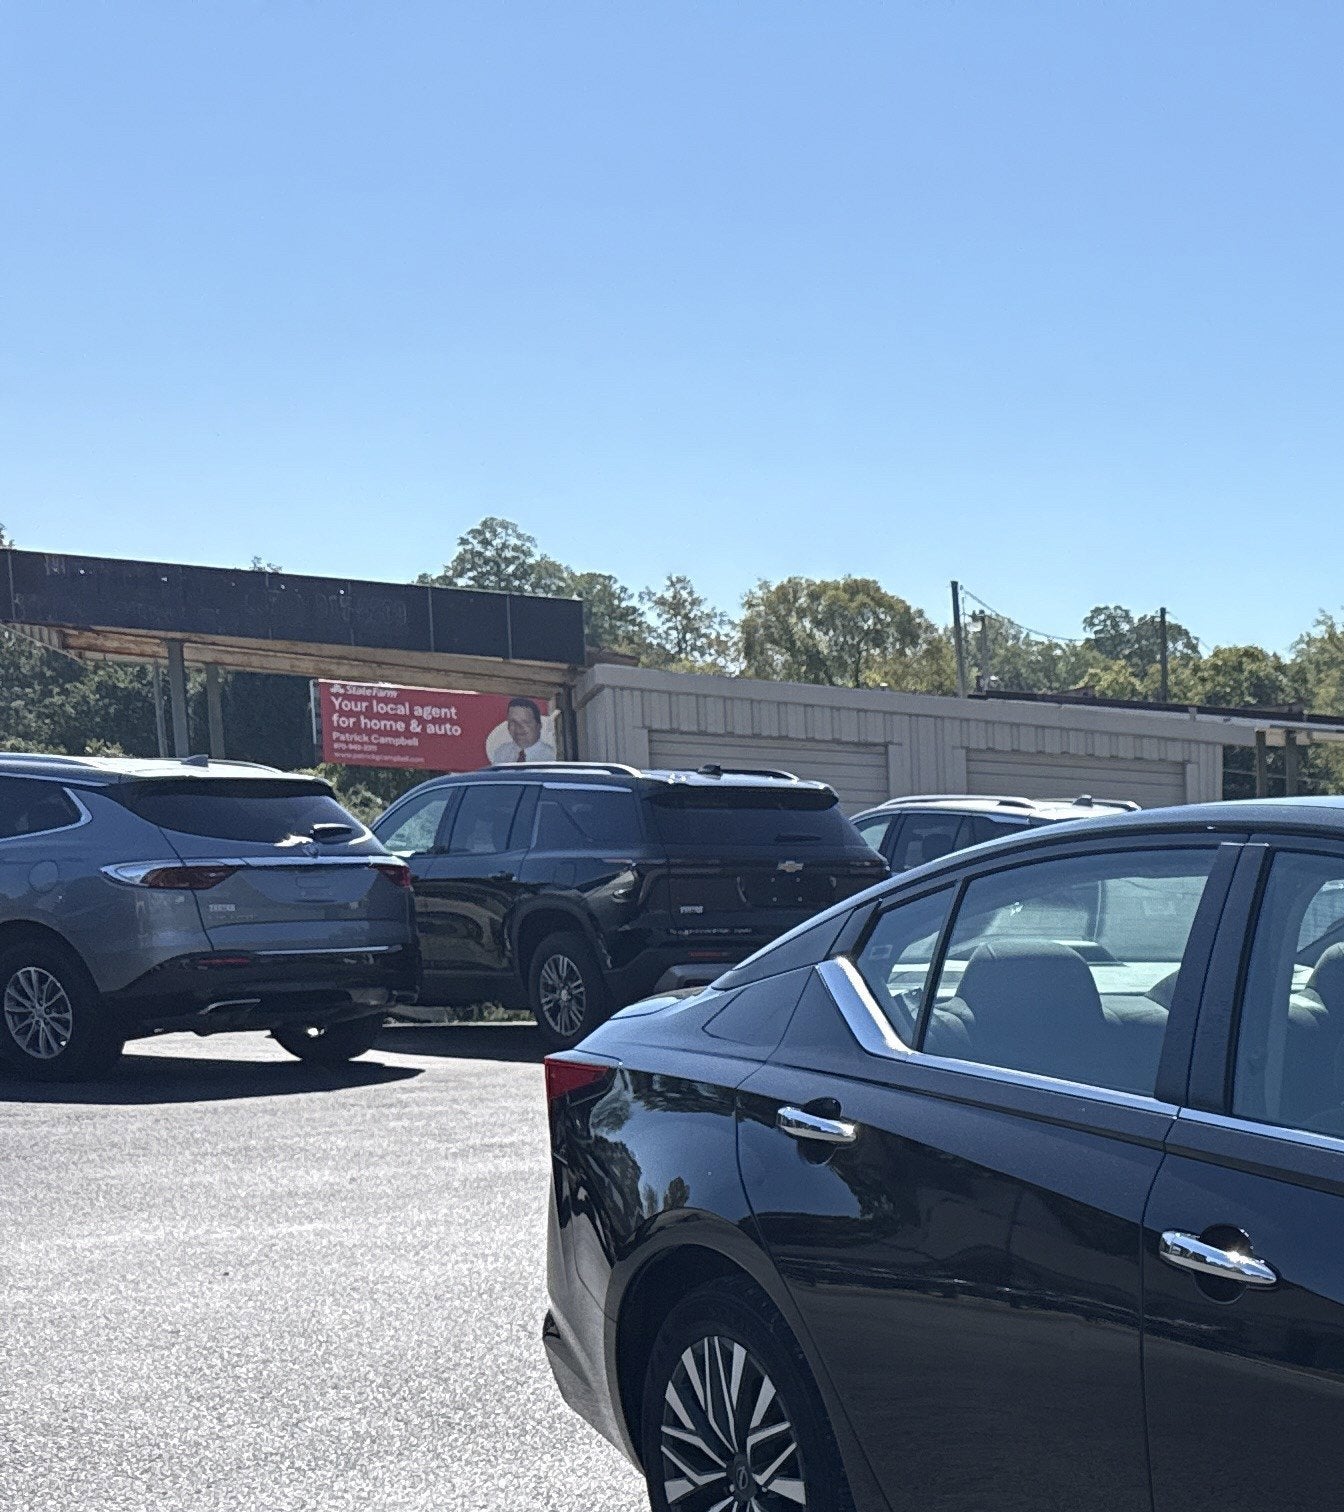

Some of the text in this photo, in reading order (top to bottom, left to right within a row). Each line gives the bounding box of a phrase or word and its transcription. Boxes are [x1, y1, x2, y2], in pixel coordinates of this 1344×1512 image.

[330, 696, 457, 720] Your local agent
[331, 713, 462, 736] for home & auto
[332, 731, 419, 747] Patrick Campbell
